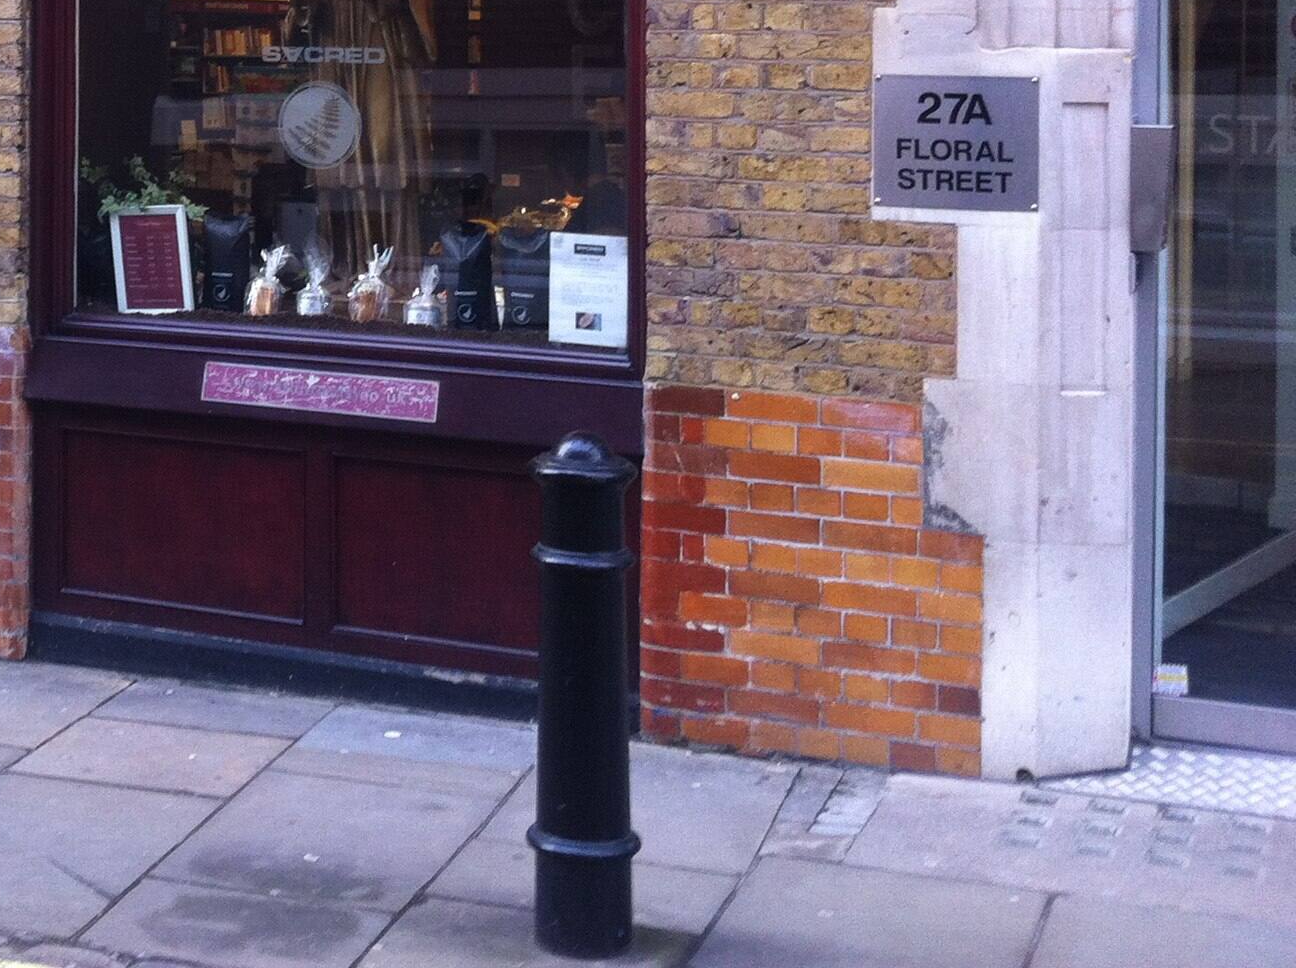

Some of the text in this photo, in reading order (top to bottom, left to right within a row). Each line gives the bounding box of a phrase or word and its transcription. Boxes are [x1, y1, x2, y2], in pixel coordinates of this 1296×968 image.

[262, 46, 386, 65] SACRED
[917, 92, 992, 125] 27A
[896, 138, 1014, 164] FLORAL
[897, 168, 1013, 194] STREET
